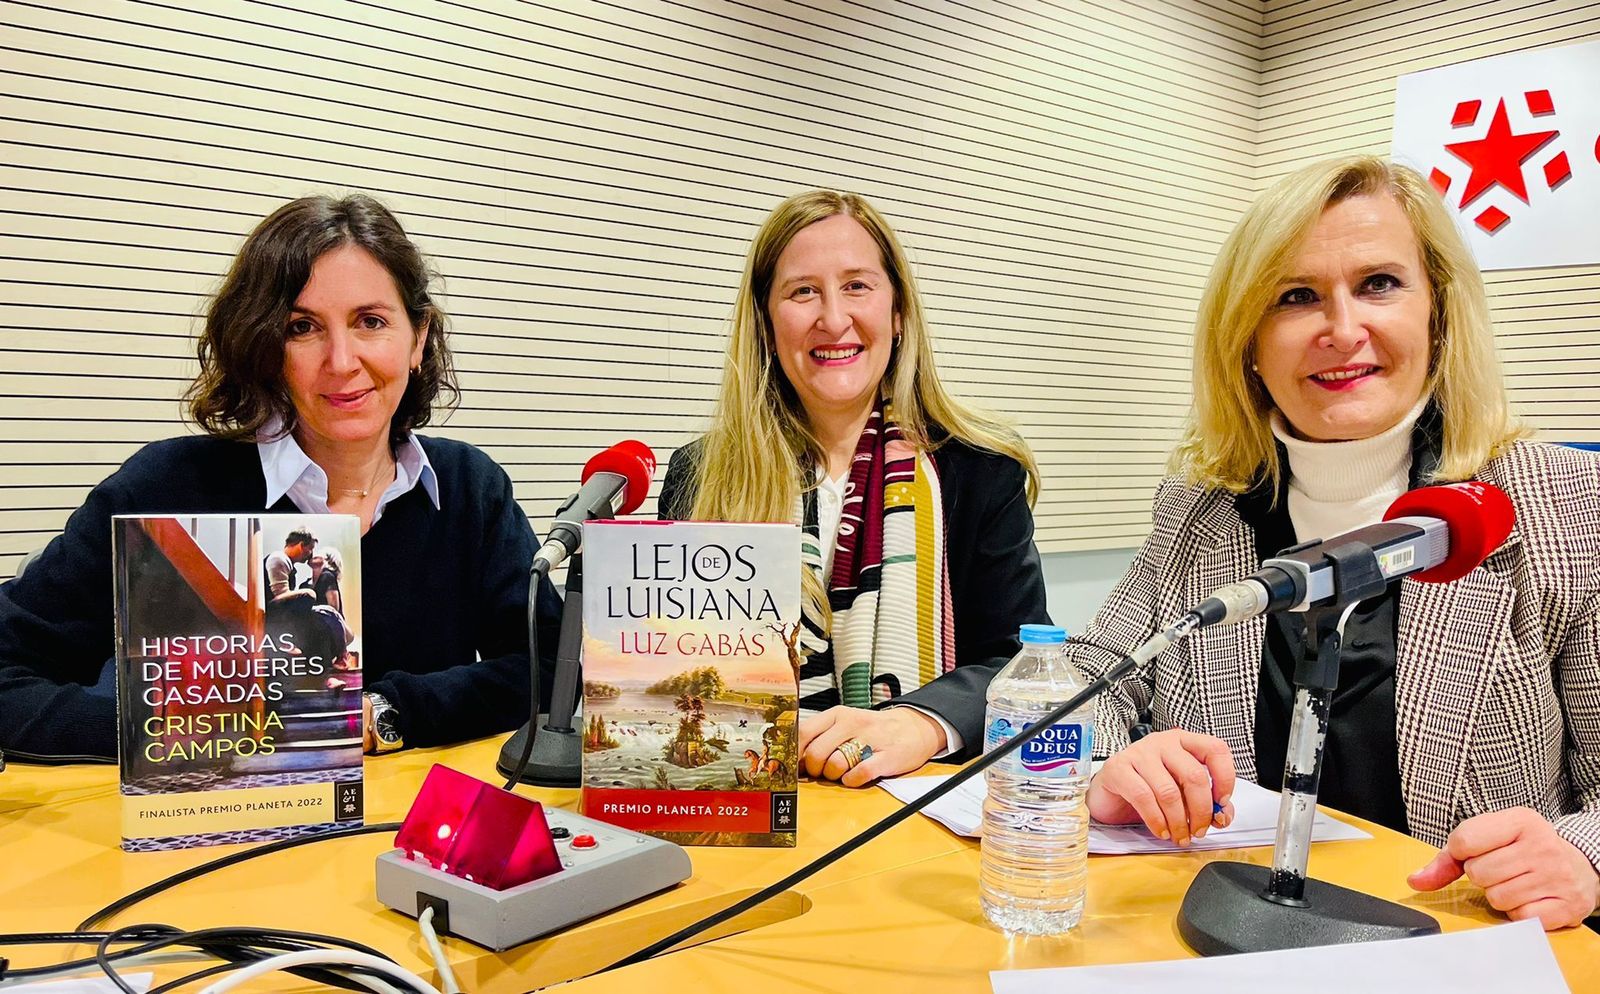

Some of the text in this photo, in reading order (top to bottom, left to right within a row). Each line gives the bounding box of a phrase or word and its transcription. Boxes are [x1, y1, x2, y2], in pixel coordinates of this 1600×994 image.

[632, 543, 757, 582] LEJOS
[702, 557, 721, 569] DE
[607, 586, 782, 621] LUISIANA
[141, 633, 295, 657] HISTORIAS
[621, 627, 766, 656] LUZ GABÁS
[142, 656, 325, 681] DE MUJERES
[143, 682, 284, 706] CASADAS
[144, 711, 284, 736] CRISTINA
[144, 736, 276, 763] CAMPOS
[1029, 741, 1076, 754] DEUS
[139, 797, 323, 819] FINALISTA PREMIO PLANETA 2022
[603, 803, 749, 816] PREMIO PLANETA 2022
